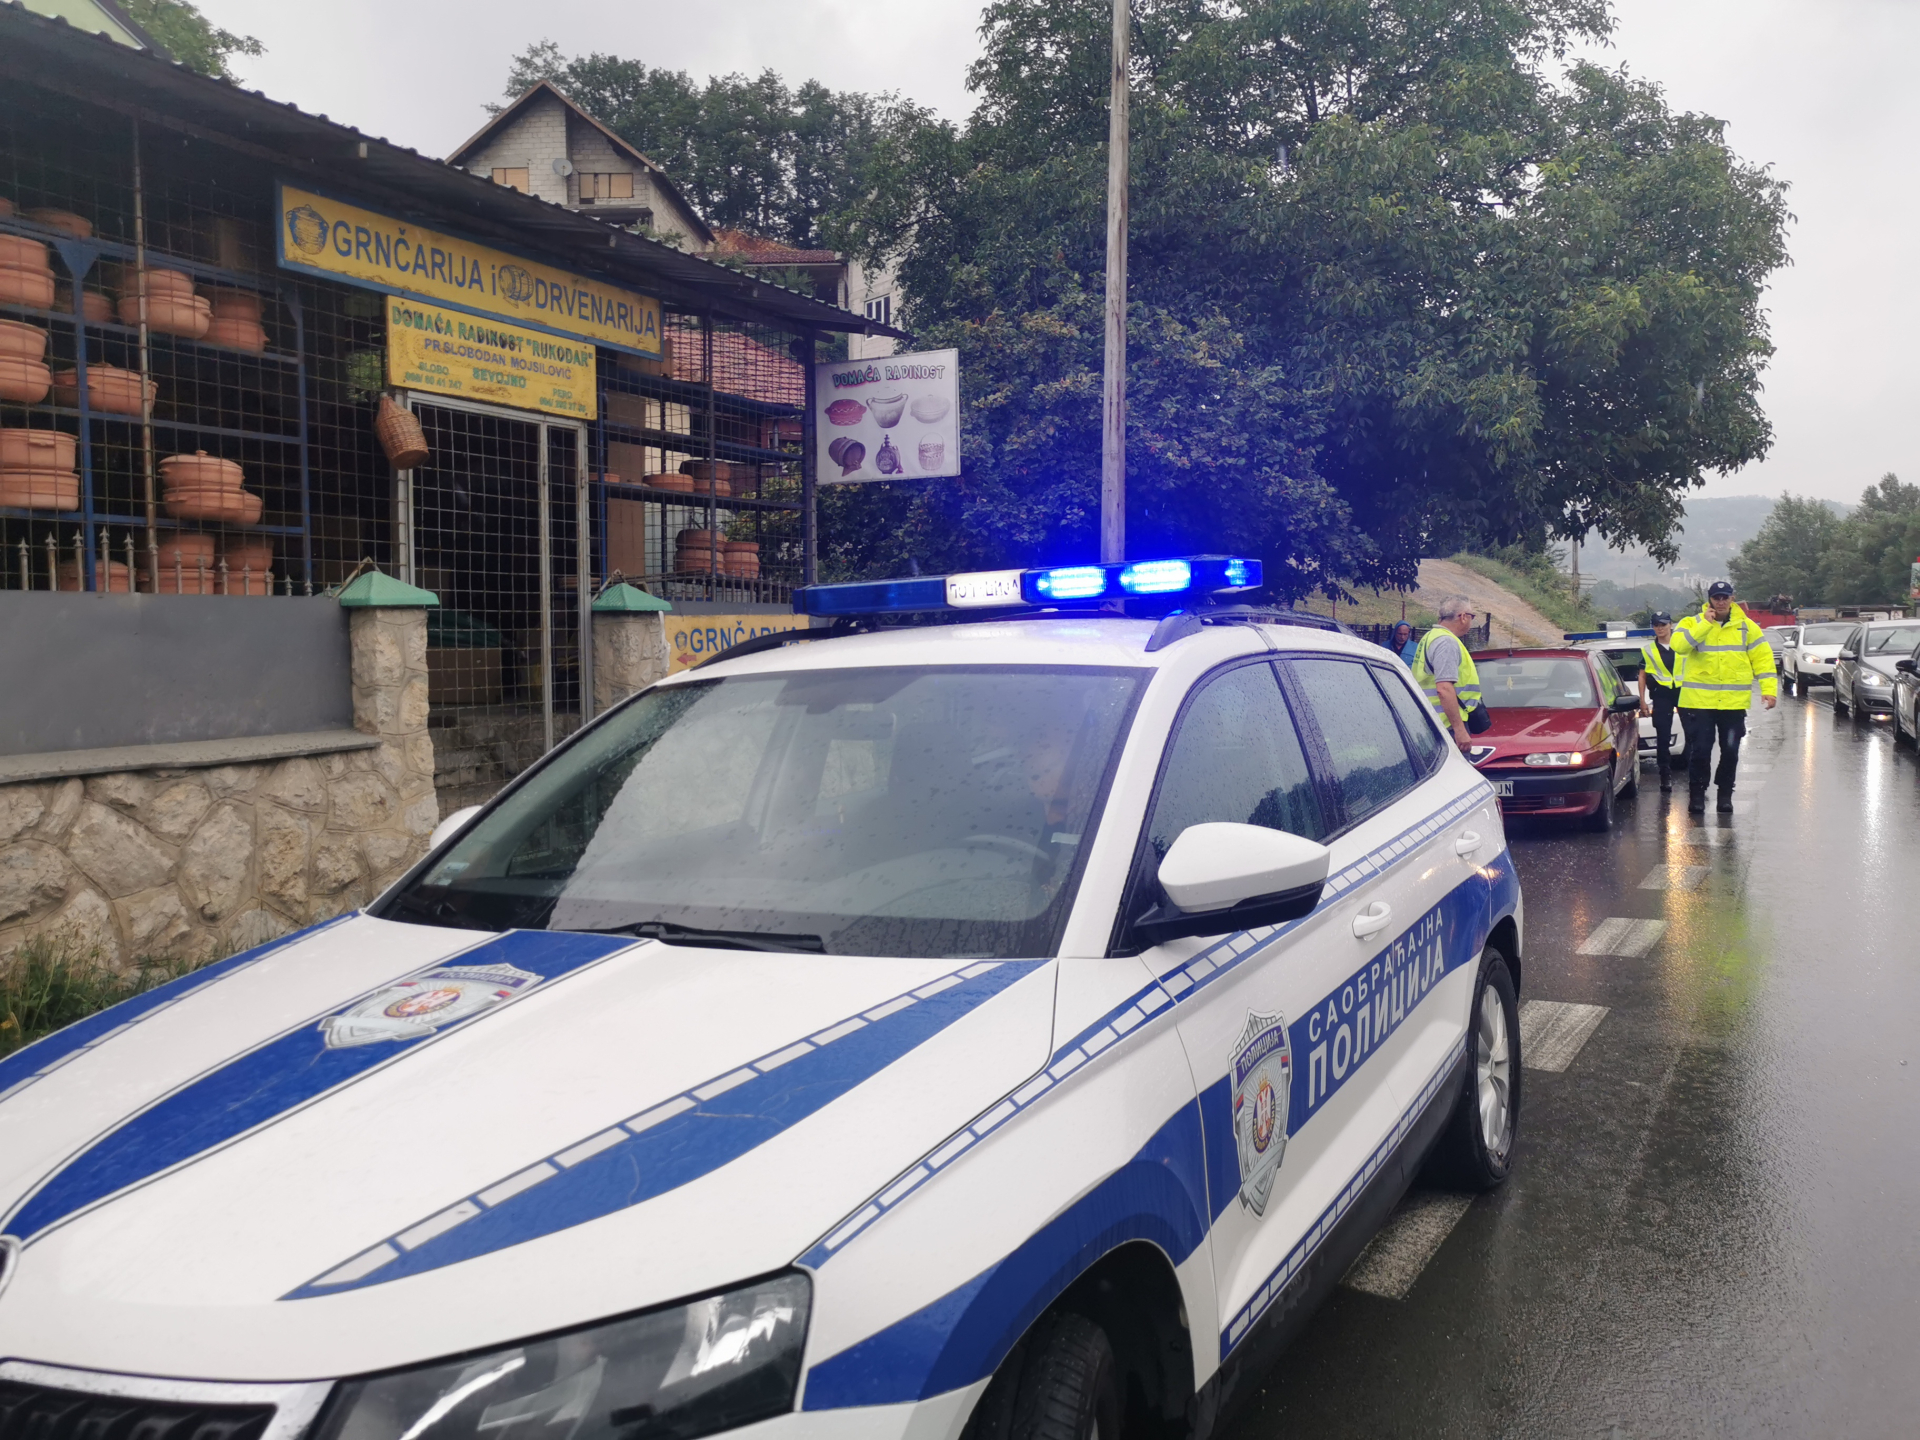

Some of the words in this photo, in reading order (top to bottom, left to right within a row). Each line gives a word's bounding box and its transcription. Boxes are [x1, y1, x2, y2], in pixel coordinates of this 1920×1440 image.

[333, 220, 484, 293] GRNČARIJA
[491, 264, 497, 296] i
[535, 278, 657, 339] DRVENARIJA
[392, 306, 453, 337] DOMAĆA
[458, 322, 524, 353] RADINOST
[526, 338, 593, 367] "RUKODAR"
[418, 361, 449, 376] SLOBO
[510, 357, 572, 380] MOJSILOVIĆ
[832, 365, 881, 388] DOMAĆA
[885, 364, 945, 381] RADINOST
[1309, 907, 1443, 1043] САОБРАЋАЈНА
[1308, 934, 1445, 1109] ПОЛИЦИЈА
[1240, 1029, 1279, 1074] ПОЛИЦИЈА
